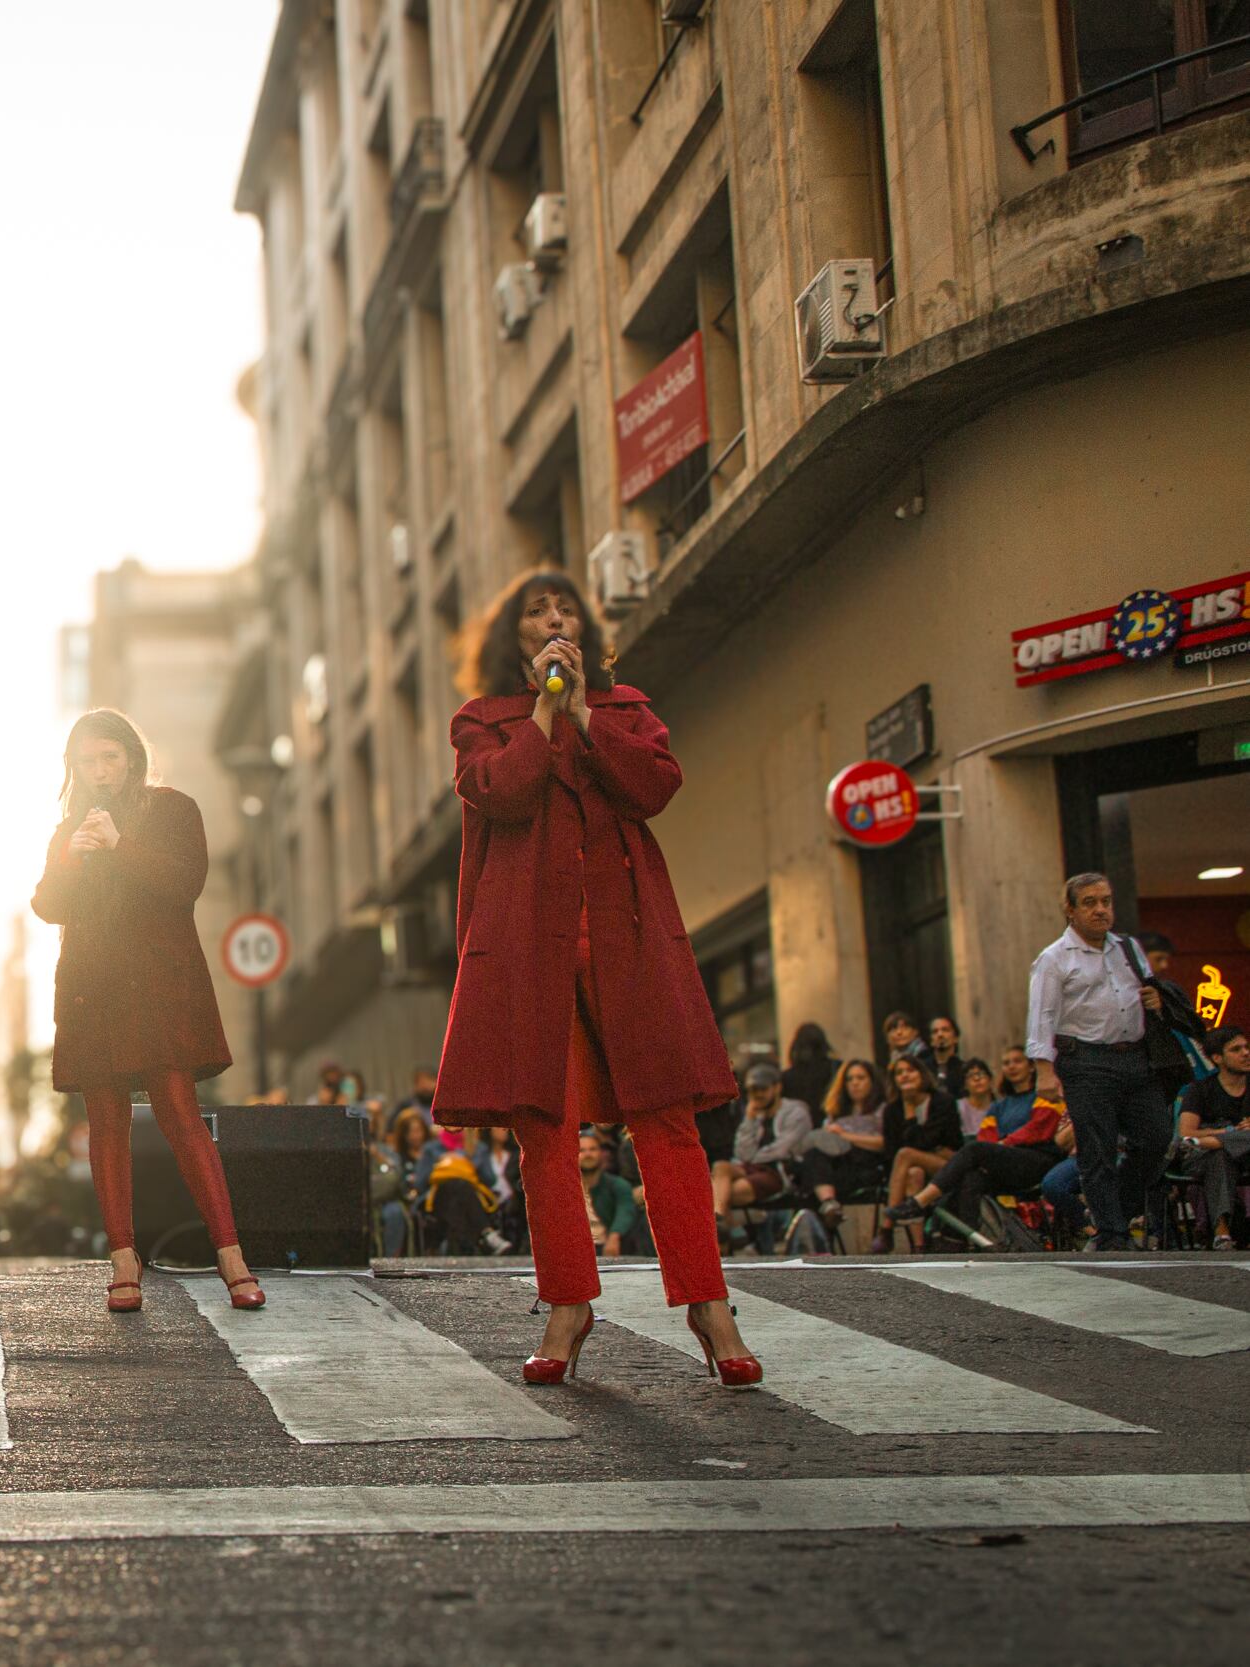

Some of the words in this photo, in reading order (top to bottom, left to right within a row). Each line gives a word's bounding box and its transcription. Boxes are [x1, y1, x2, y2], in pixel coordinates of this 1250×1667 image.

[1017, 621, 1108, 669] OPEN
[1125, 605, 1166, 643] 25
[842, 772, 898, 805] OPEN
[874, 790, 912, 821] HS!
[237, 931, 277, 965] 10
